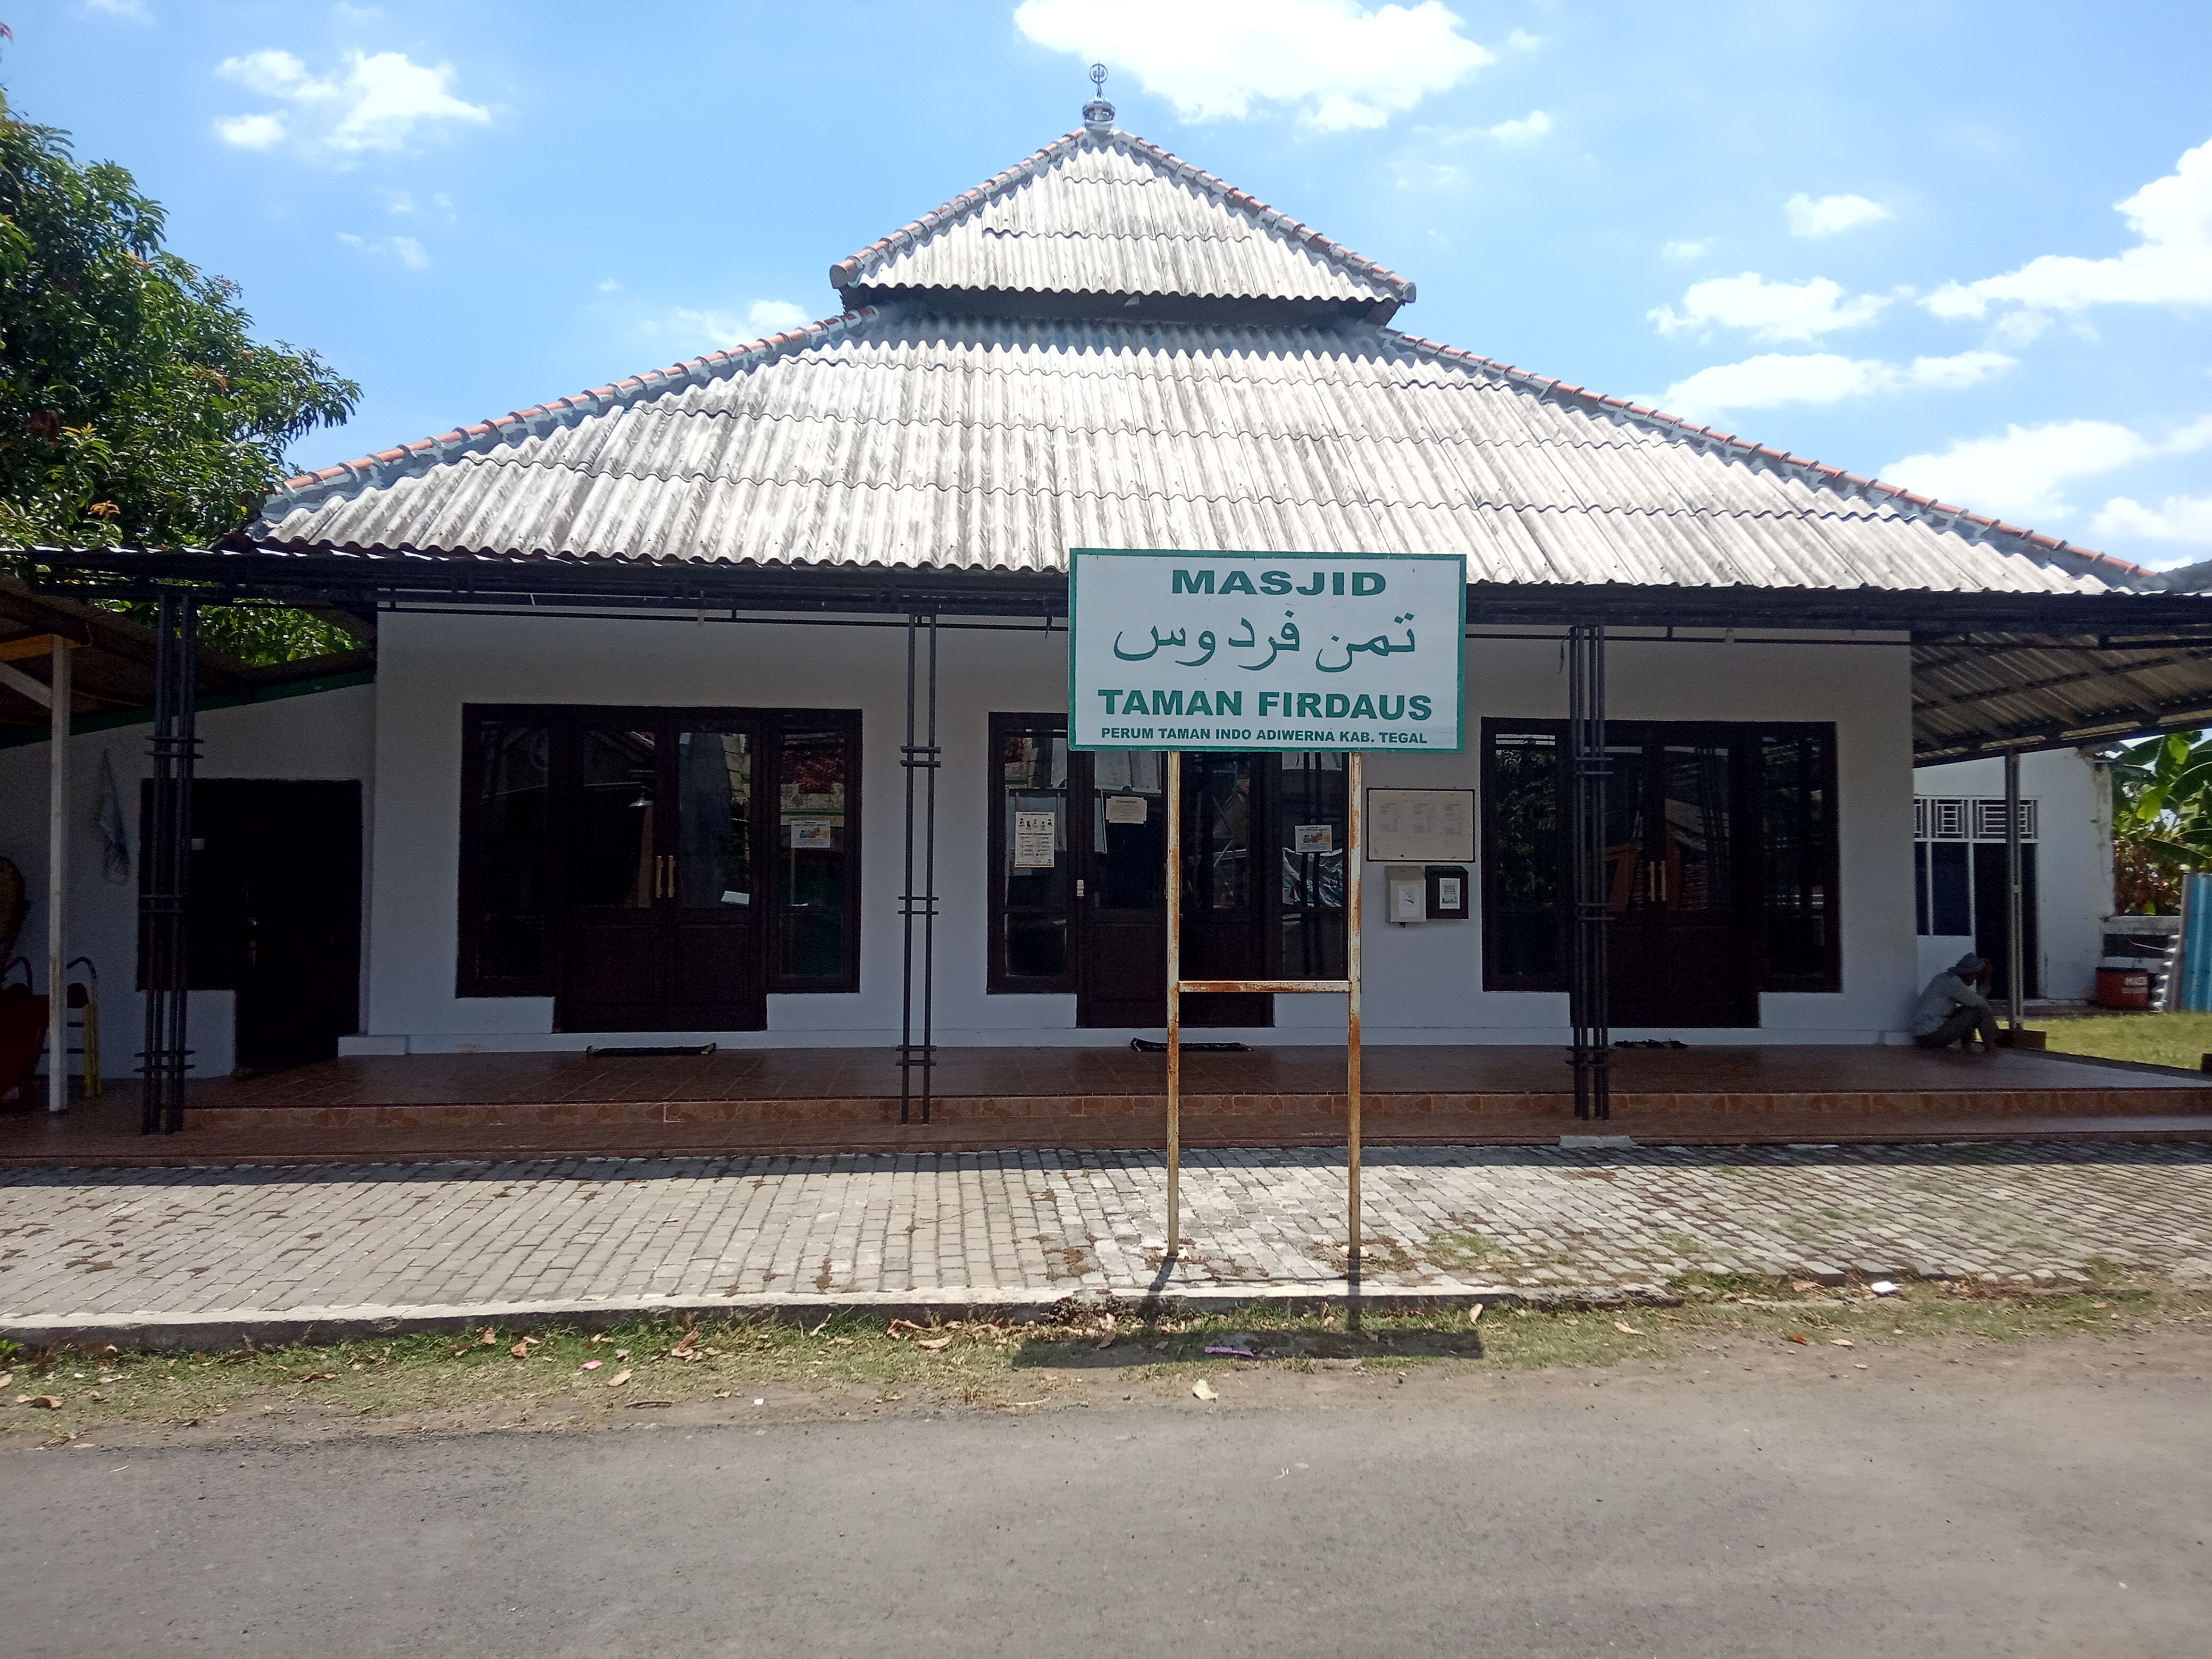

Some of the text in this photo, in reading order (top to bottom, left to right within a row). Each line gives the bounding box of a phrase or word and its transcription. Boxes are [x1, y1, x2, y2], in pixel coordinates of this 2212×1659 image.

[1172, 569, 1386, 597] MASJID
[1113, 609, 1415, 673] تمن فردوس
[1097, 689, 1432, 721] TAMAN FIRDAUS
[1101, 727, 1428, 744] PERUM TAMAN INDO ADIWERNA KAB. TEGAL
